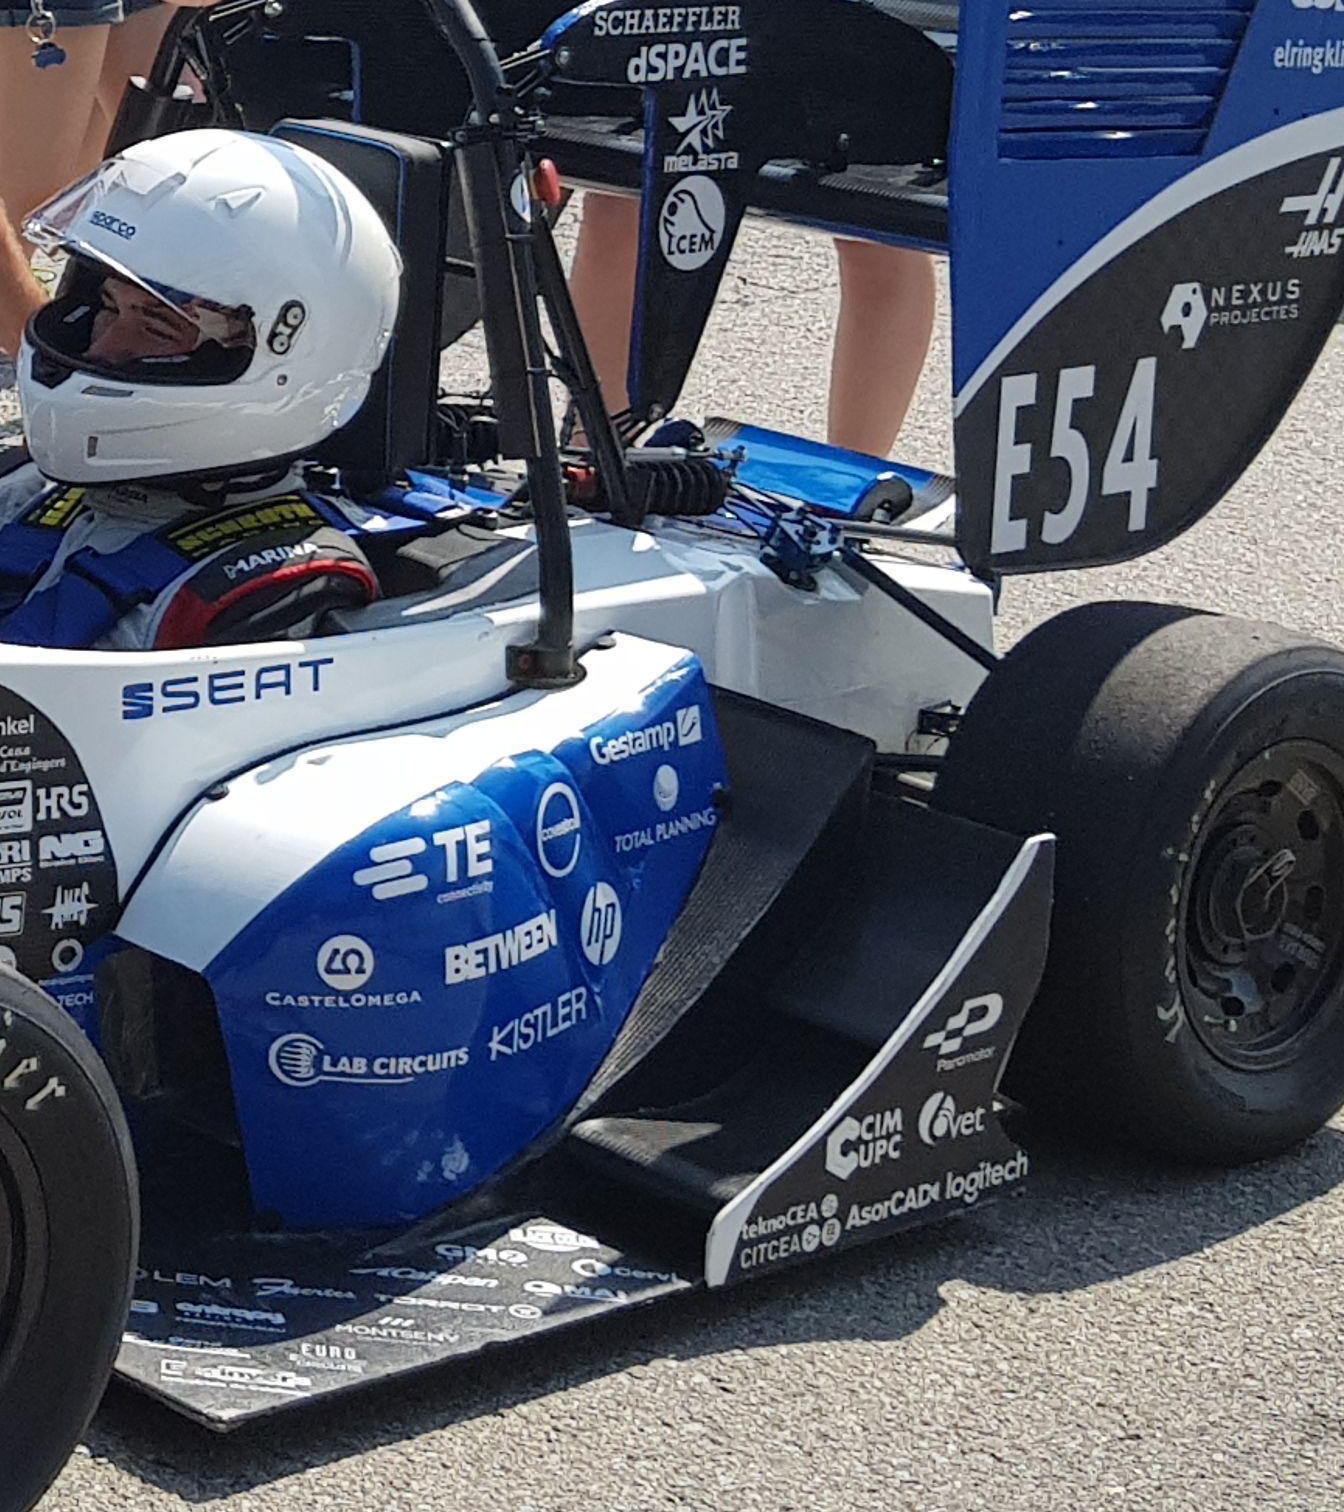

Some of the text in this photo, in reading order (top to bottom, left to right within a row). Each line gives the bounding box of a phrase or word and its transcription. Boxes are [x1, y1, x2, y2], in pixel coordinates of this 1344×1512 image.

[593, 6, 742, 37] SCHAEFFLER
[627, 38, 748, 84] dSPACE
[90, 210, 136, 239] sparco
[666, 233, 715, 256] LCEM
[1211, 278, 1302, 307] NEXUS
[1210, 303, 1300, 327] PROJECTES
[991, 356, 1159, 555] E54
[222, 542, 323, 580] MARINA
[162, 657, 334, 716] SEAT
[589, 721, 675, 766] Gestamp
[35, 783, 89, 821] HRS
[614, 807, 717, 853] TOTAL PLANNING
[433, 819, 493, 883] TE
[445, 909, 558, 985] BETWEEN
[488, 987, 589, 1061] KISTLER
[322, 1046, 469, 1076] LAB CIRCUITS
[861, 1107, 903, 1138] CIM
[859, 1133, 902, 1168] UPC
[945, 1150, 1029, 1205] logitech
[740, 1202, 819, 1241] teknoCEA
[740, 1236, 802, 1270] CITCEA
